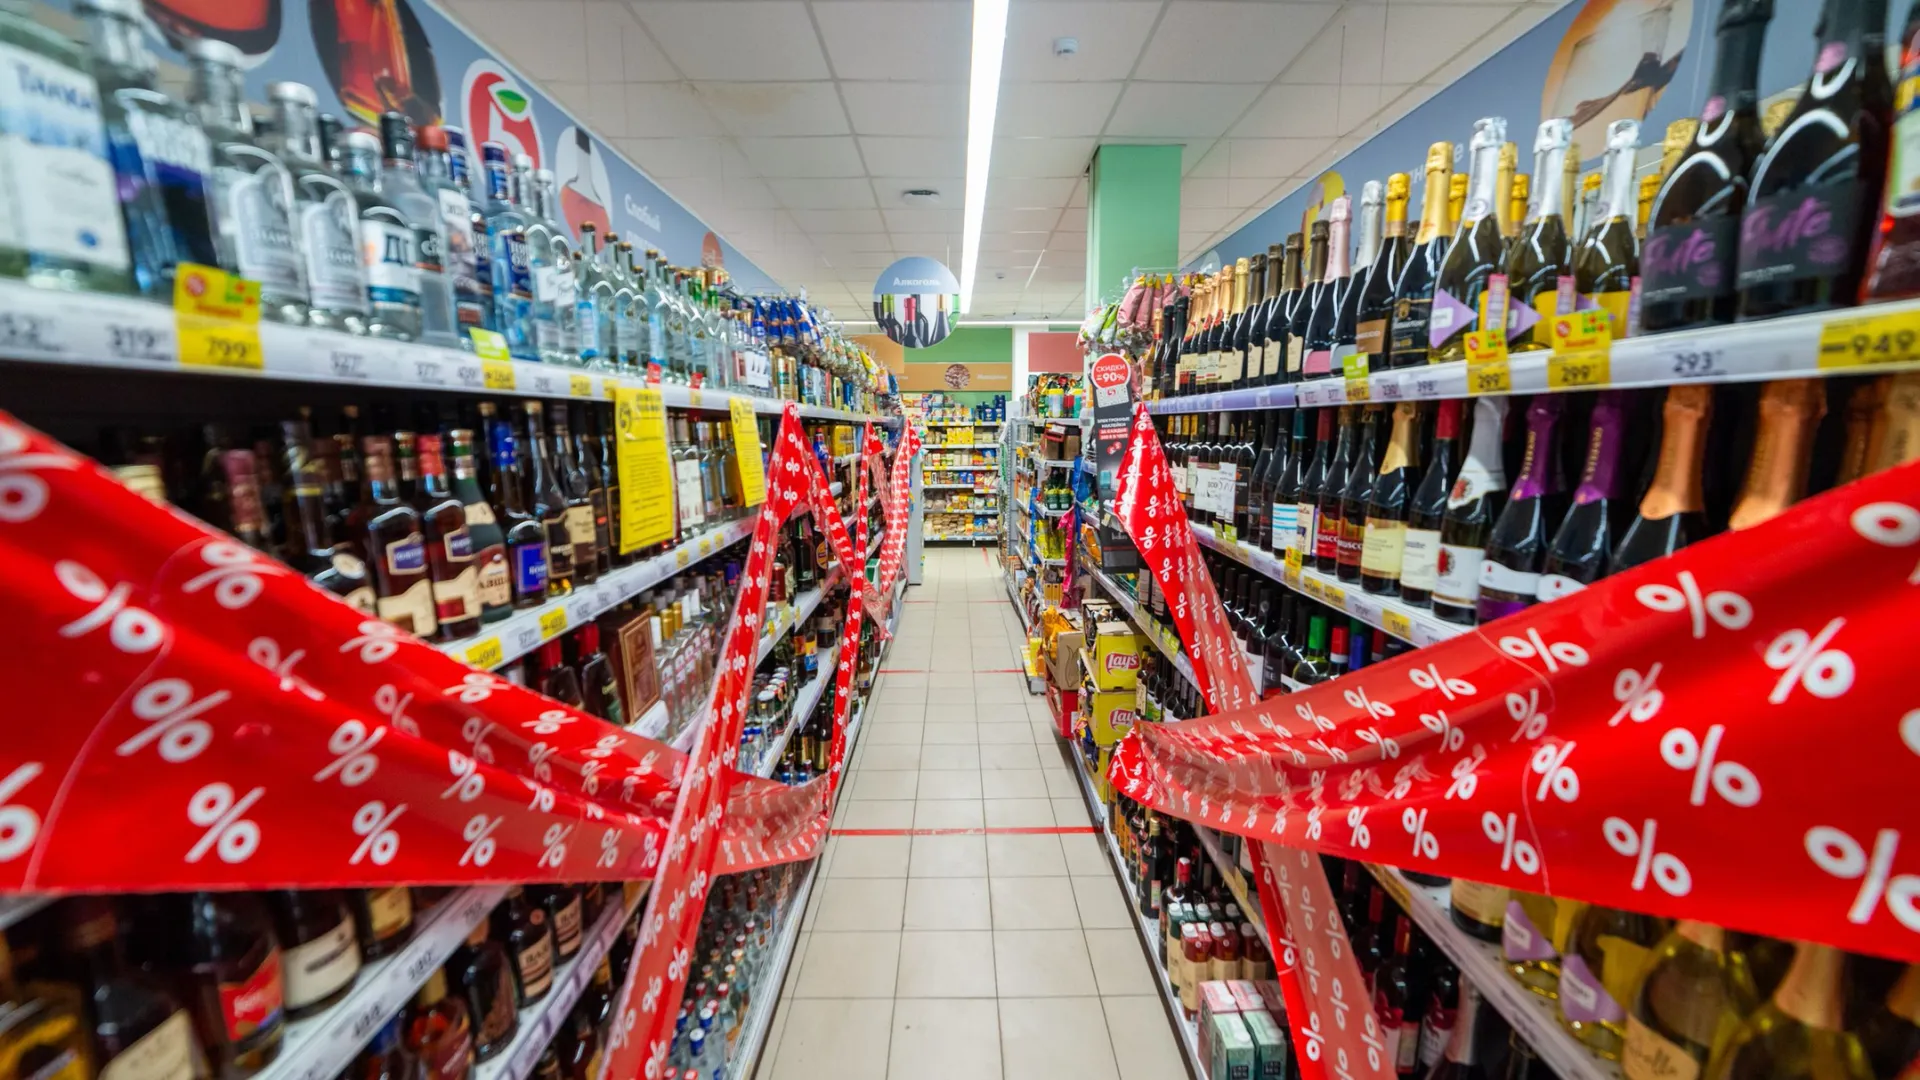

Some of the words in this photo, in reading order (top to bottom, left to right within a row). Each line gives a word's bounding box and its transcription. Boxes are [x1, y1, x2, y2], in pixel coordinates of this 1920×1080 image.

[893, 277, 941, 287] Алкоголь
[1851, 330, 1914, 356] 949
[1096, 364, 1126, 373] СКИДКИ
[1672, 352, 1713, 373] 293
[1102, 371, 1126, 383] 90%
